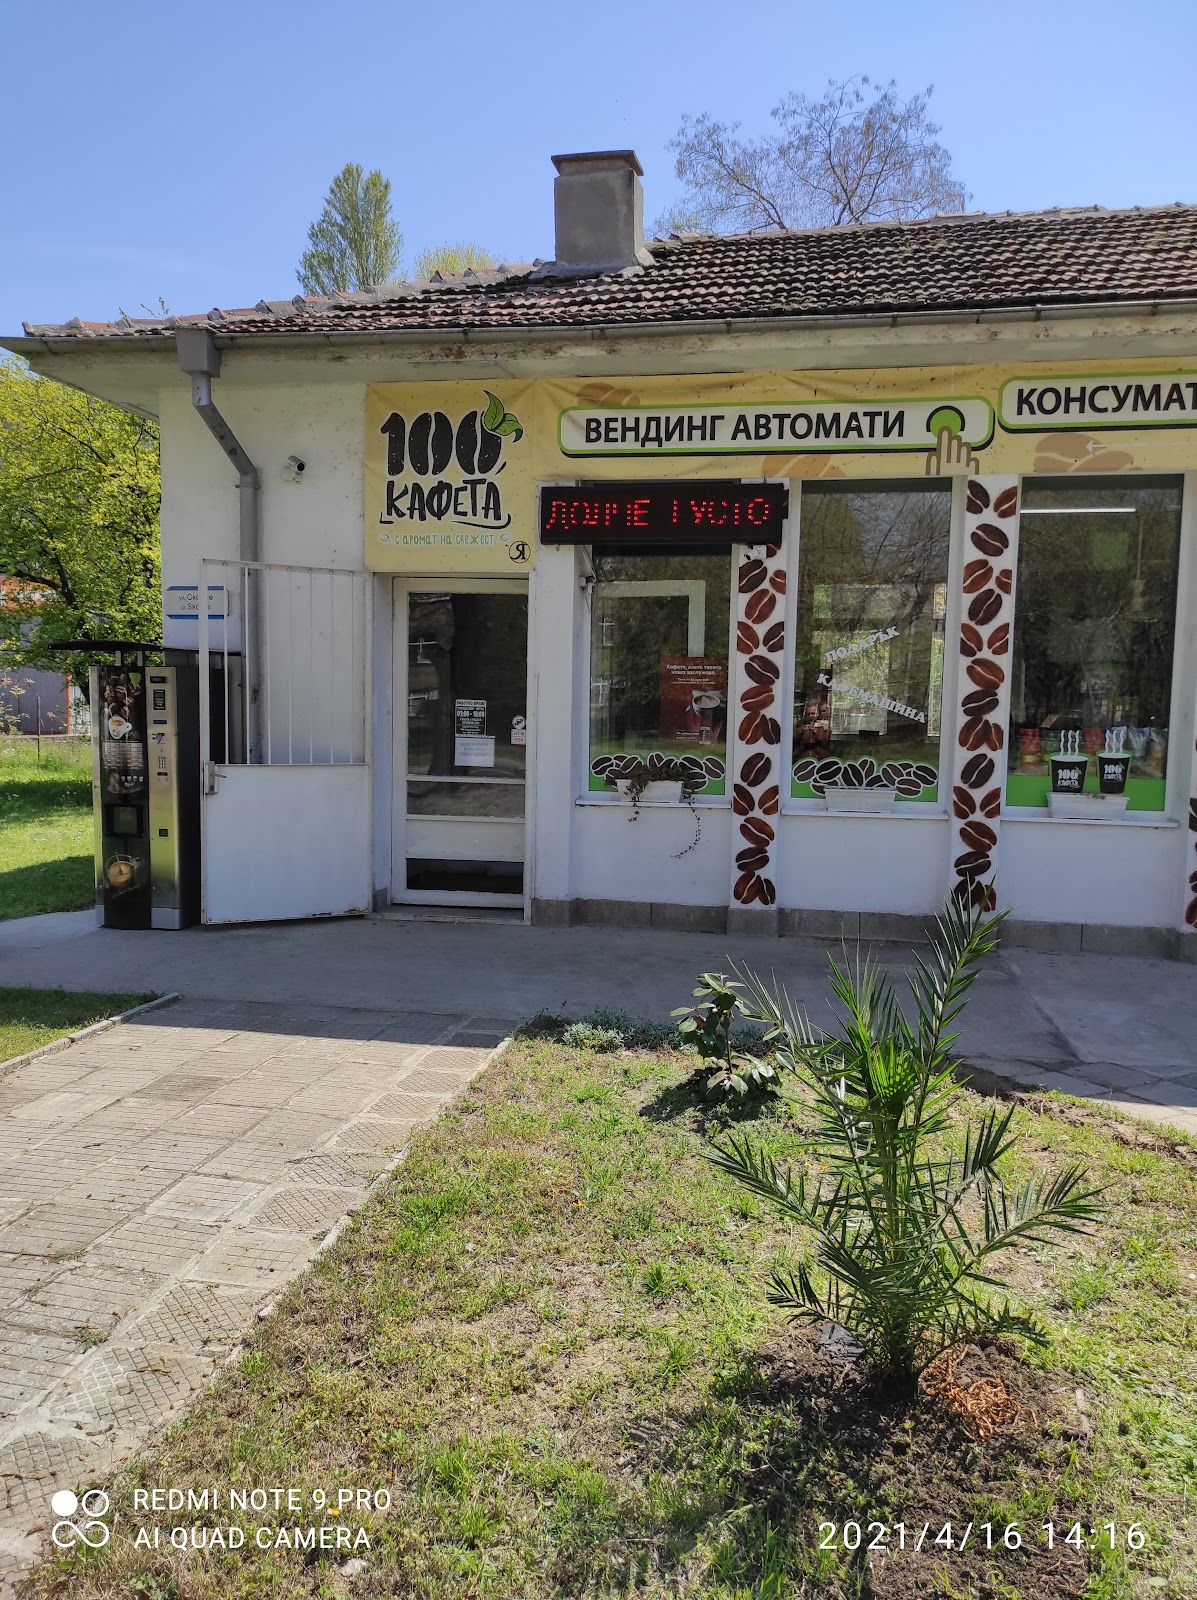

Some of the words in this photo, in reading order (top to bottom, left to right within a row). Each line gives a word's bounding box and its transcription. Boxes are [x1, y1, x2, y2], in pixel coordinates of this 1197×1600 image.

[380, 410, 502, 476] 100
[585, 414, 725, 448] ВЕНДИНГ
[730, 410, 905, 441] АВТОМАТИ
[386, 478, 502, 521] КАФЕТА
[817, 673, 926, 723] КАФЕМАШИНА
[1057, 769, 1079, 779] 100
